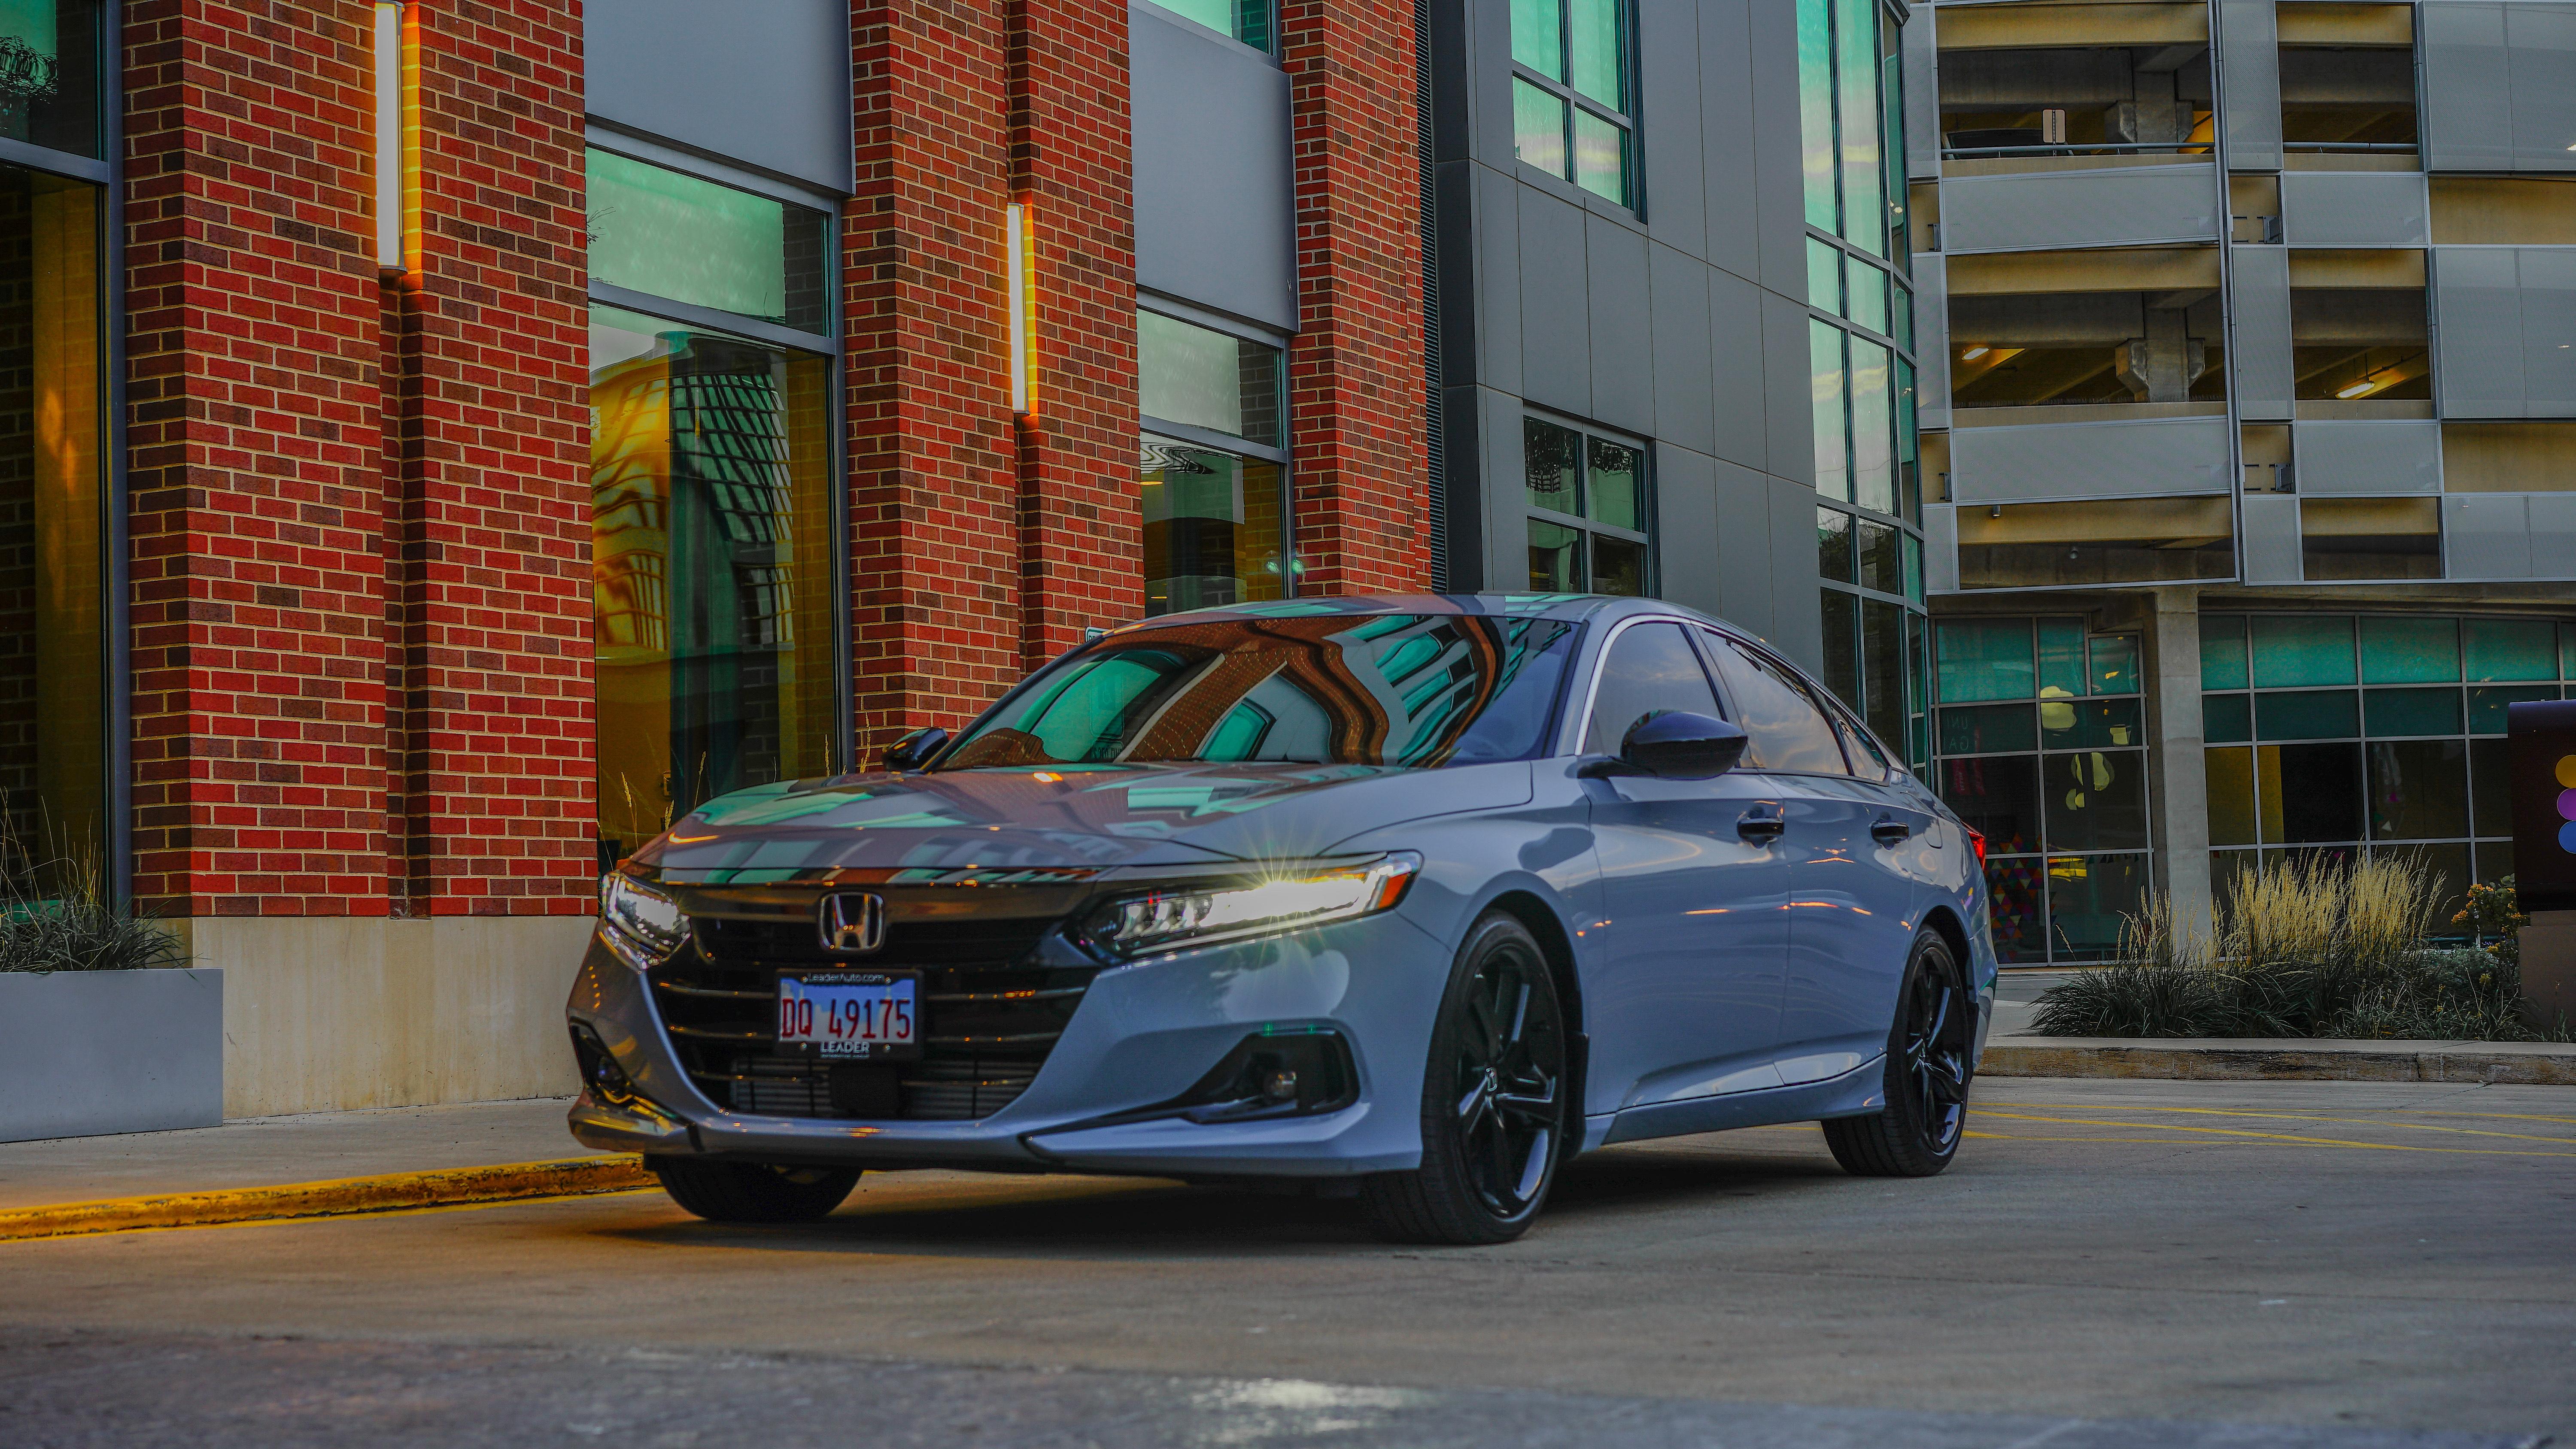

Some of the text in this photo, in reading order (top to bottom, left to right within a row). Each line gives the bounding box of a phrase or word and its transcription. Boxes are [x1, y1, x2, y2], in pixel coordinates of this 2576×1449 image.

[807, 972, 885, 982] LeaderAuto.com
[781, 998, 911, 1039] DQ 49175
[820, 1040, 870, 1053] LEADER
